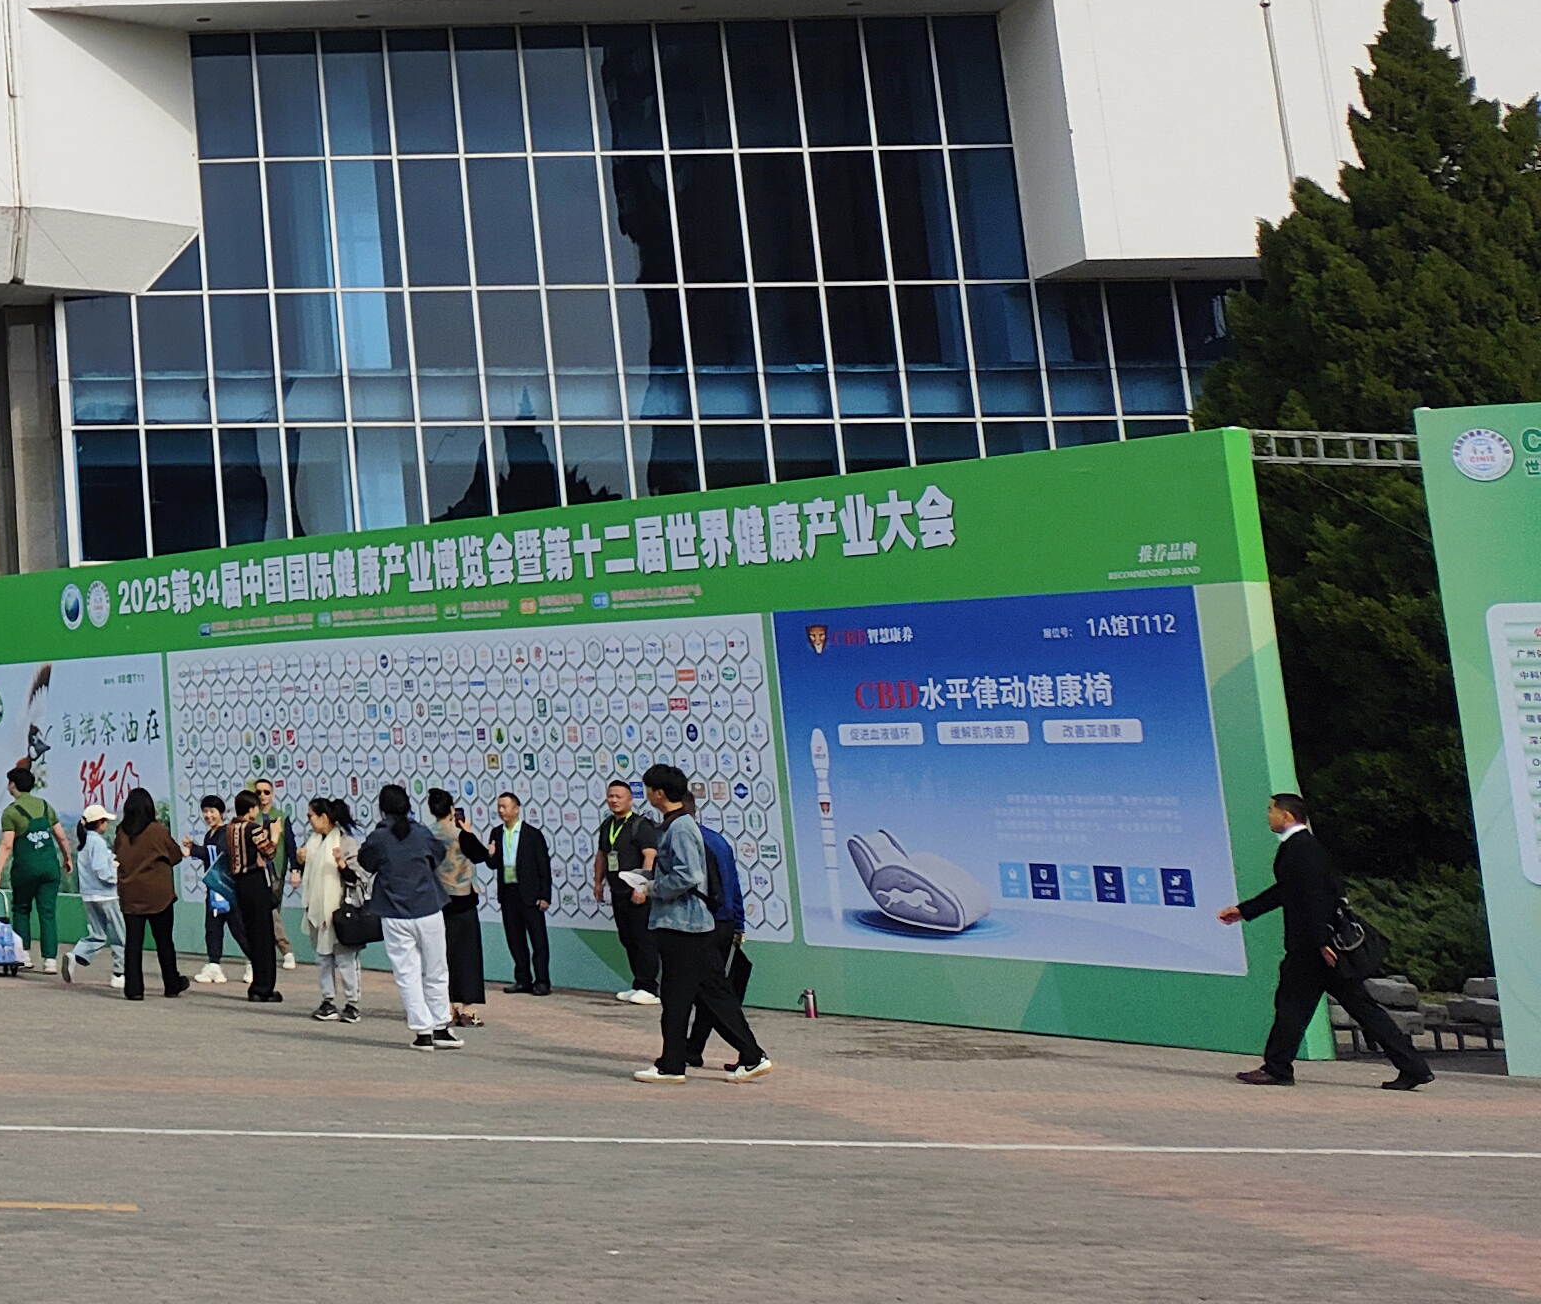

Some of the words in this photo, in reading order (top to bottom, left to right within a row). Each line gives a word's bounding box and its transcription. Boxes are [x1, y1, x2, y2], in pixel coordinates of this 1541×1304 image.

[117, 484, 957, 616] 2025第34届中国国际健康产业博览会暨第十二届世界健康产业大会
[1139, 541, 1197, 563] 推荐品牌
[1108, 568, 1170, 581] RECOMMENDED
[1171, 566, 1201, 576] BRAND
[1086, 613, 1176, 637] 1A馆T112
[855, 671, 1113, 711] CBD水平律动健康椅
[61, 708, 161, 747] 高端茶油在
[850, 727, 911, 741] 促进血液循环
[950, 725, 1015, 740] 缓解肌肉疲劳
[1062, 724, 1122, 739] 改善亚健康
